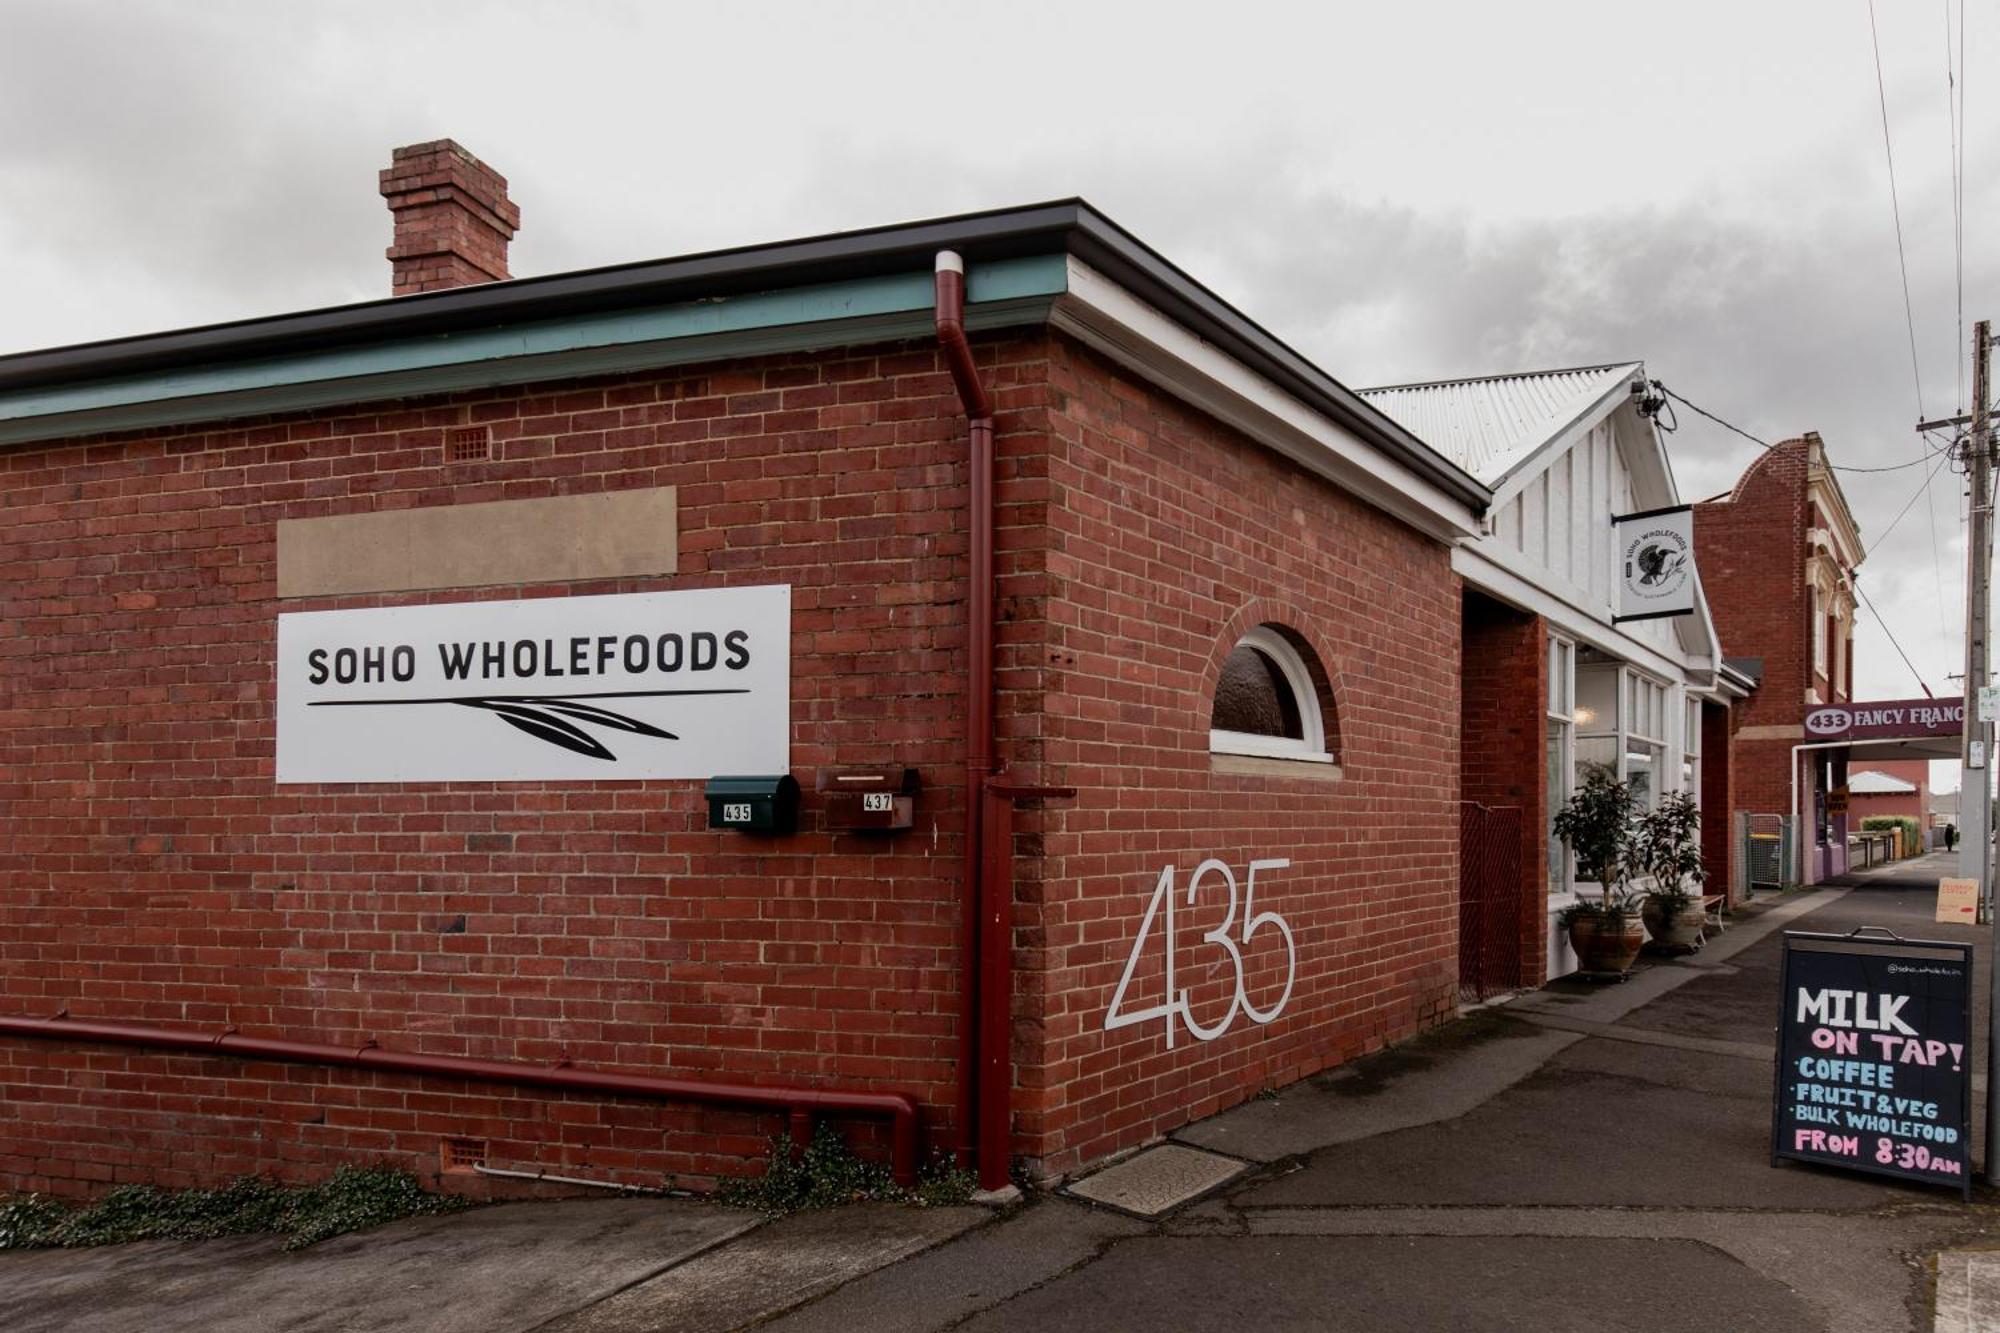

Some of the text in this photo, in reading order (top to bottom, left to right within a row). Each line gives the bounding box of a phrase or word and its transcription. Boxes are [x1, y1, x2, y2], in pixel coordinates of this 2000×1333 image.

[308, 630, 751, 685] SOHO WHOLEFOODS
[1810, 714, 1847, 729] 433
[1854, 708, 1904, 726] FANCY
[725, 806, 749, 820] 435
[865, 795, 890, 809] 437
[1105, 858, 1296, 1050] 435
[1797, 987, 1919, 1036] MILK
[1811, 1028, 1963, 1072] ON TAP!
[1799, 1056, 1894, 1089] COFFEE
[1796, 1104, 1958, 1144] BULK WHOLEFOOD
[1795, 1129, 1858, 1157] FROM
